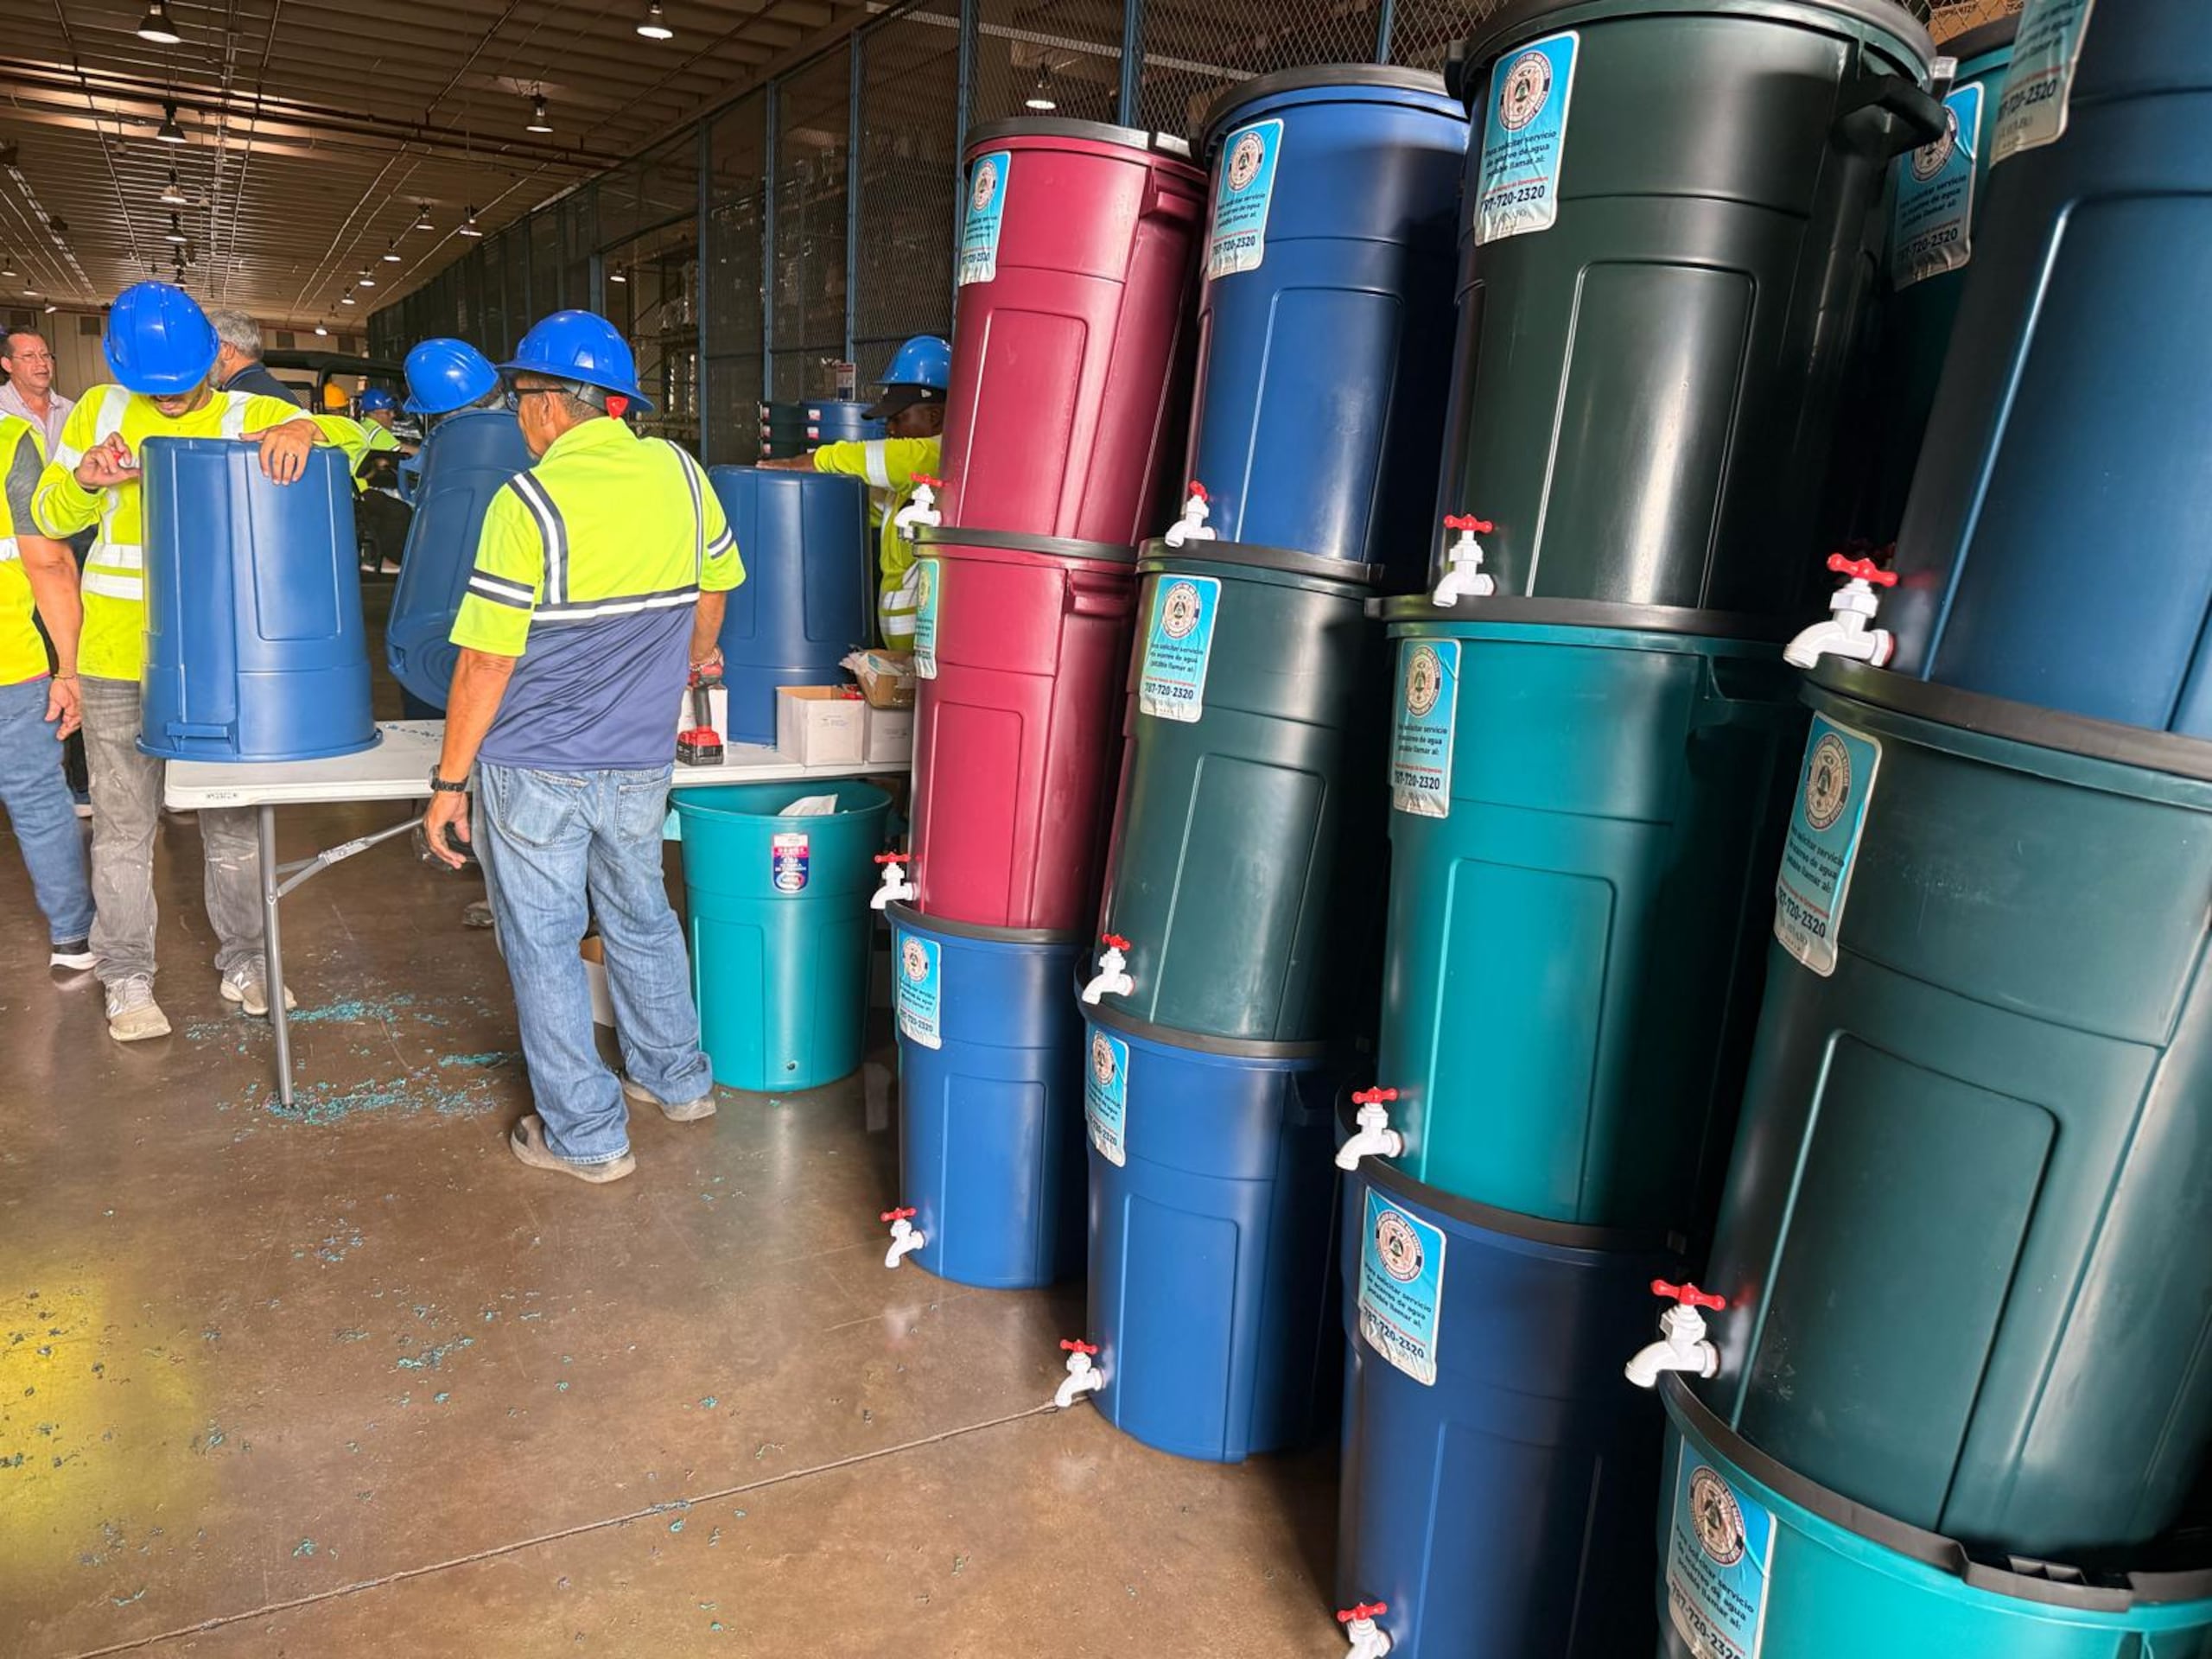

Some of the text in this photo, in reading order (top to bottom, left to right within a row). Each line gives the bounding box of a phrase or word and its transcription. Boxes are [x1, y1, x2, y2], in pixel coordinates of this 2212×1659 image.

[1524, 130, 1557, 143] servicio
[1529, 143, 1550, 154] agua
[1510, 158, 1534, 169] llamar
[1145, 681, 1194, 700] 787-720-2320
[1427, 737, 1442, 746] agua
[1778, 886, 1826, 938] 787-720-2320
[1389, 1303, 1411, 1321] llamar
[1402, 1293, 1432, 1313] servicio
[1407, 1306, 1426, 1320] agua
[1363, 1306, 1425, 1359] 787-720-2320
[1700, 1587, 1728, 1618] llamar
[1718, 1578, 1755, 1614] servicio
[1723, 1597, 1747, 1622] agua
[1671, 1580, 1743, 1659] 787-720-232
